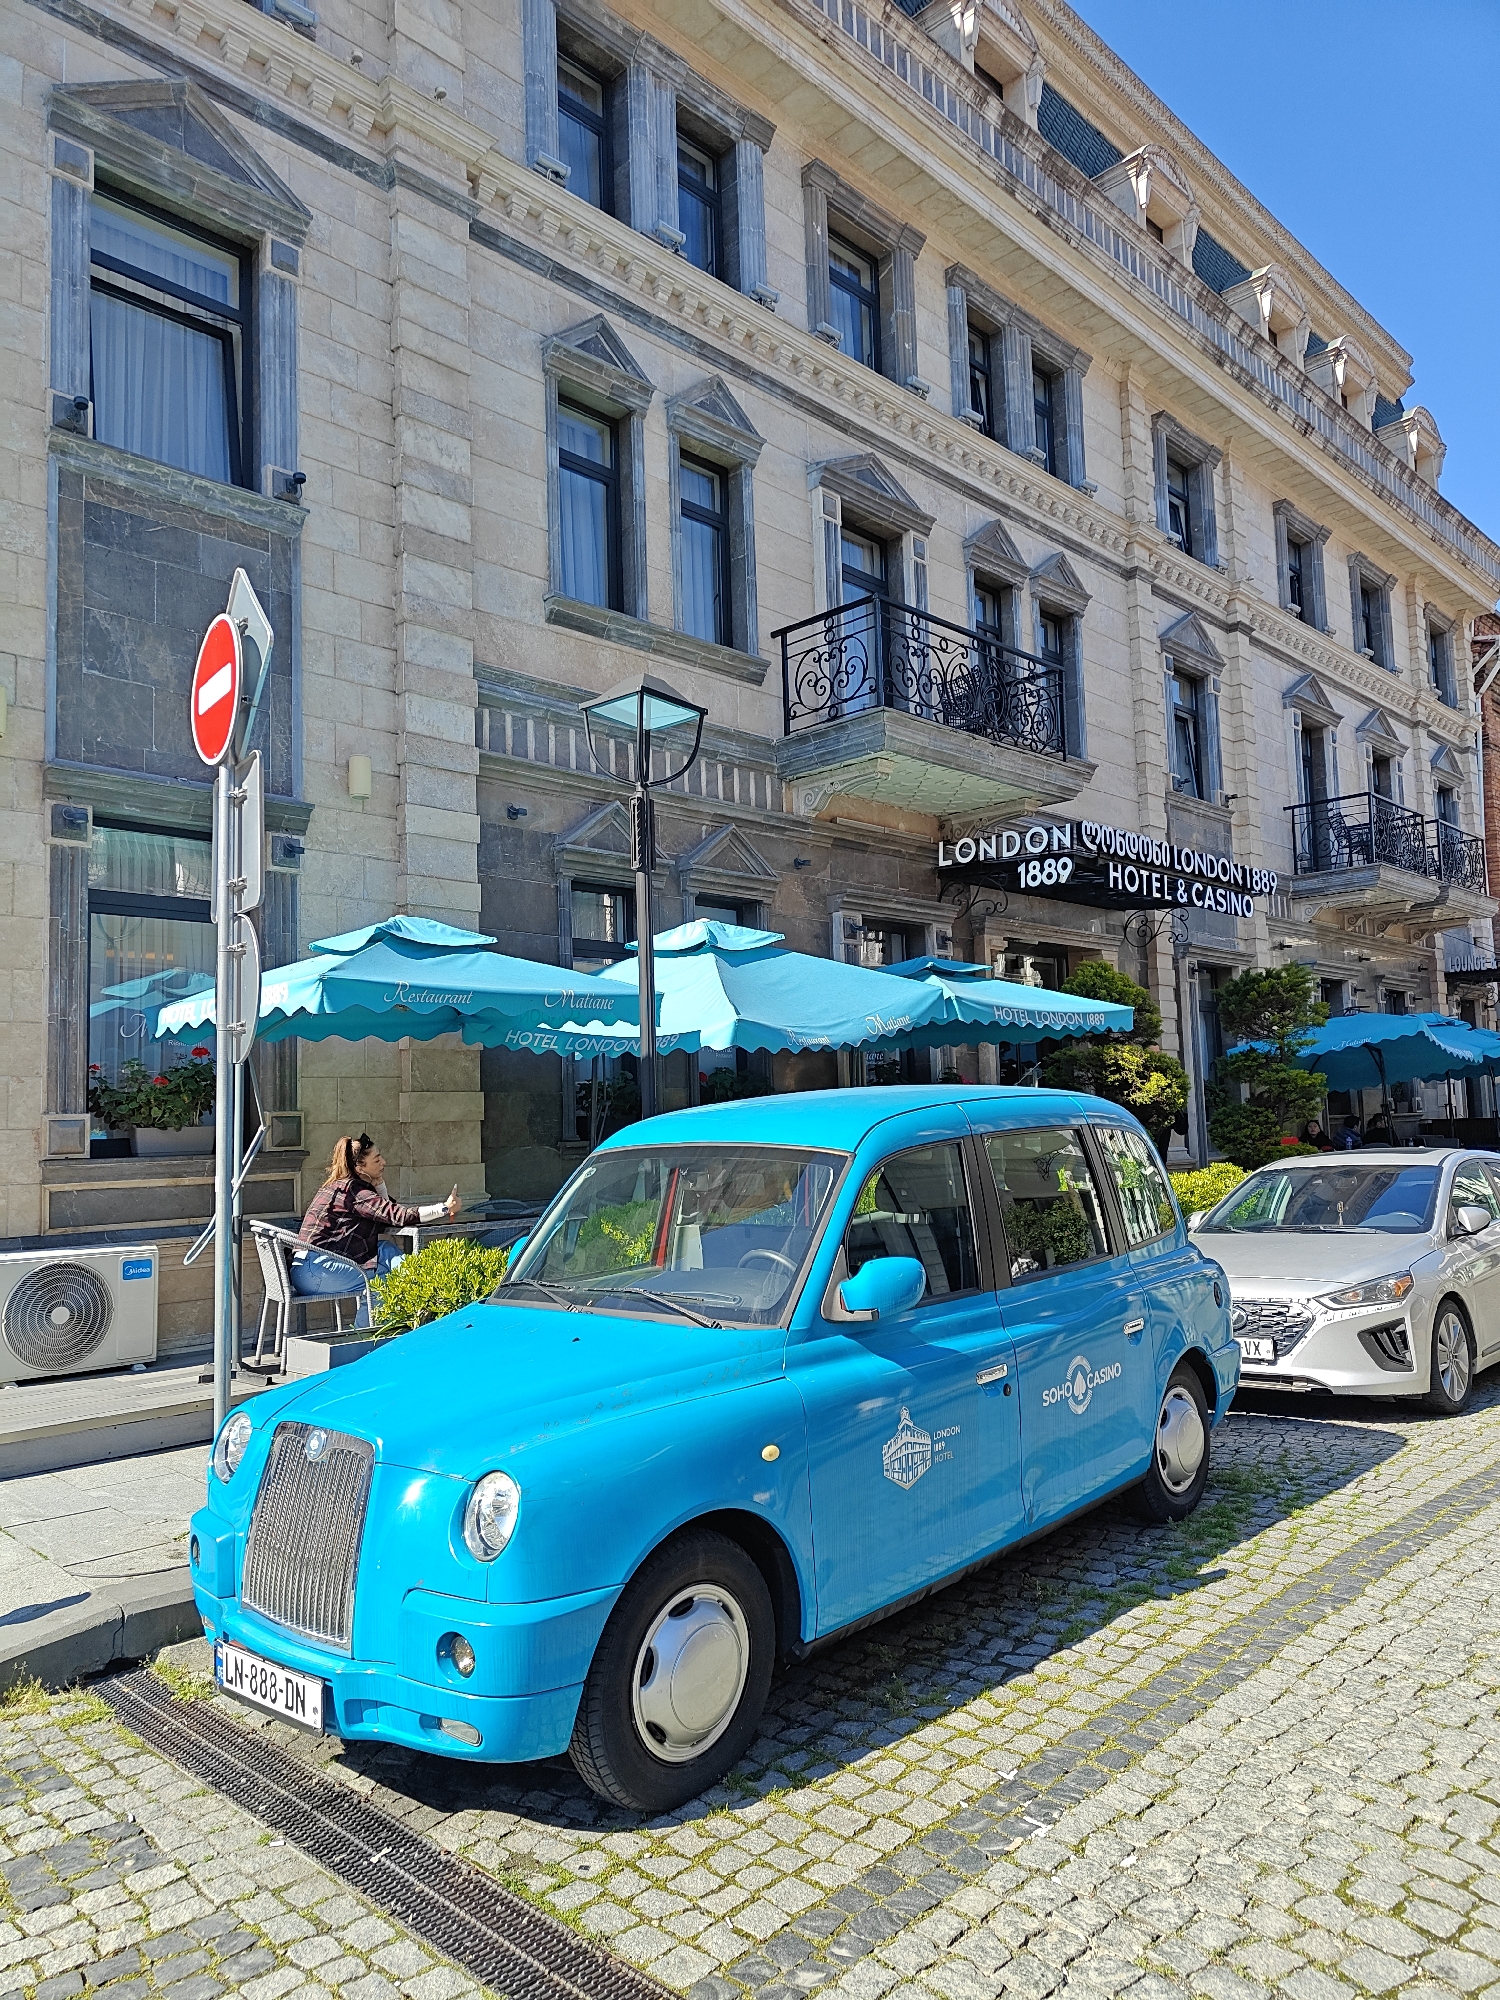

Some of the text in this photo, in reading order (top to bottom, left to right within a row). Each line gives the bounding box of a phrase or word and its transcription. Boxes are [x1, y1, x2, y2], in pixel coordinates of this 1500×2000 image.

[938, 823, 1071, 867] LONDON
[1082, 820, 1278, 895] ლონდონი LONDON 1889
[1018, 857, 1073, 888] 1889
[1109, 862, 1254, 918] HOTEL & CASINO
[1450, 955, 1487, 972] LOUNGE
[384, 981, 615, 1010] Restaurant Matiane
[161, 1002, 197, 1025] HOTEL
[865, 1013, 911, 1034] Matiane
[993, 1006, 1105, 1026] HOTEL LONDON 1889
[504, 1029, 559, 1049] HOTEL
[565, 1037, 641, 1052] LONDON
[126, 1266, 150, 1275] Midea
[1042, 1362, 1122, 1407] SOHO CASINO
[933, 1425, 960, 1440] LONDON
[934, 1451, 954, 1464] HOTEL
[225, 1651, 306, 1718] LN-888-DN
